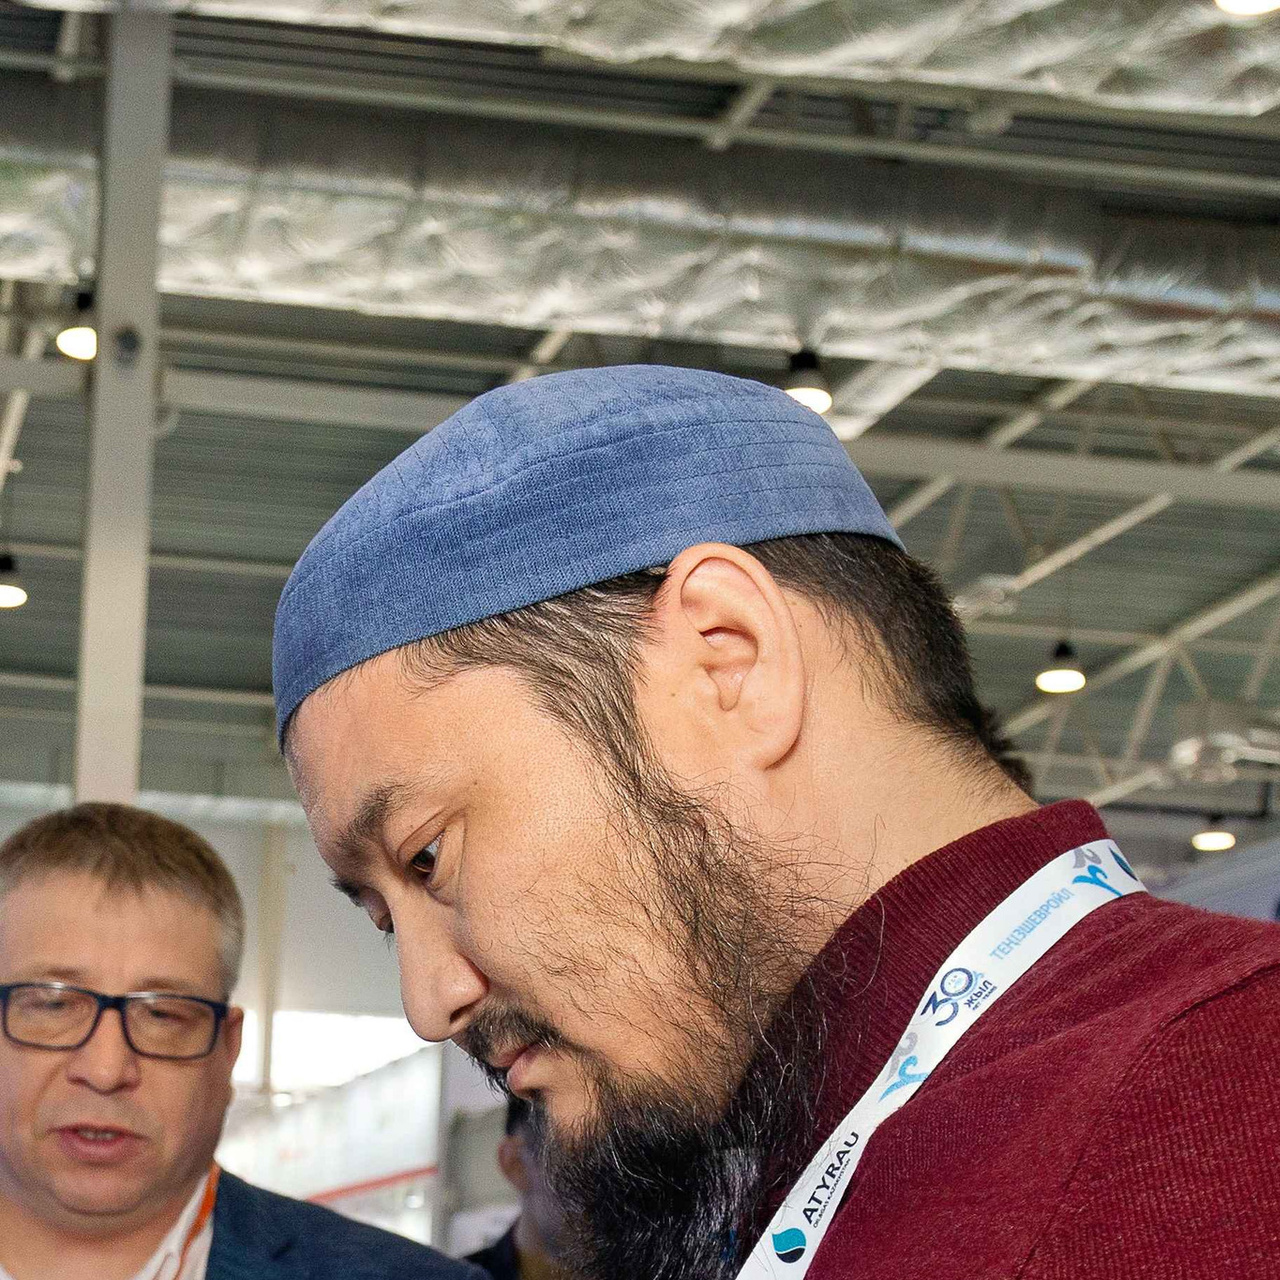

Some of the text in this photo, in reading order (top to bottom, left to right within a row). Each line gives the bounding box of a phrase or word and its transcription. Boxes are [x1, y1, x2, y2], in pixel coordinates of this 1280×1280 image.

[920, 967, 974, 1027] 30
[963, 980, 993, 1008] ЖЫЛ
[802, 1131, 859, 1225] ATYRAU
